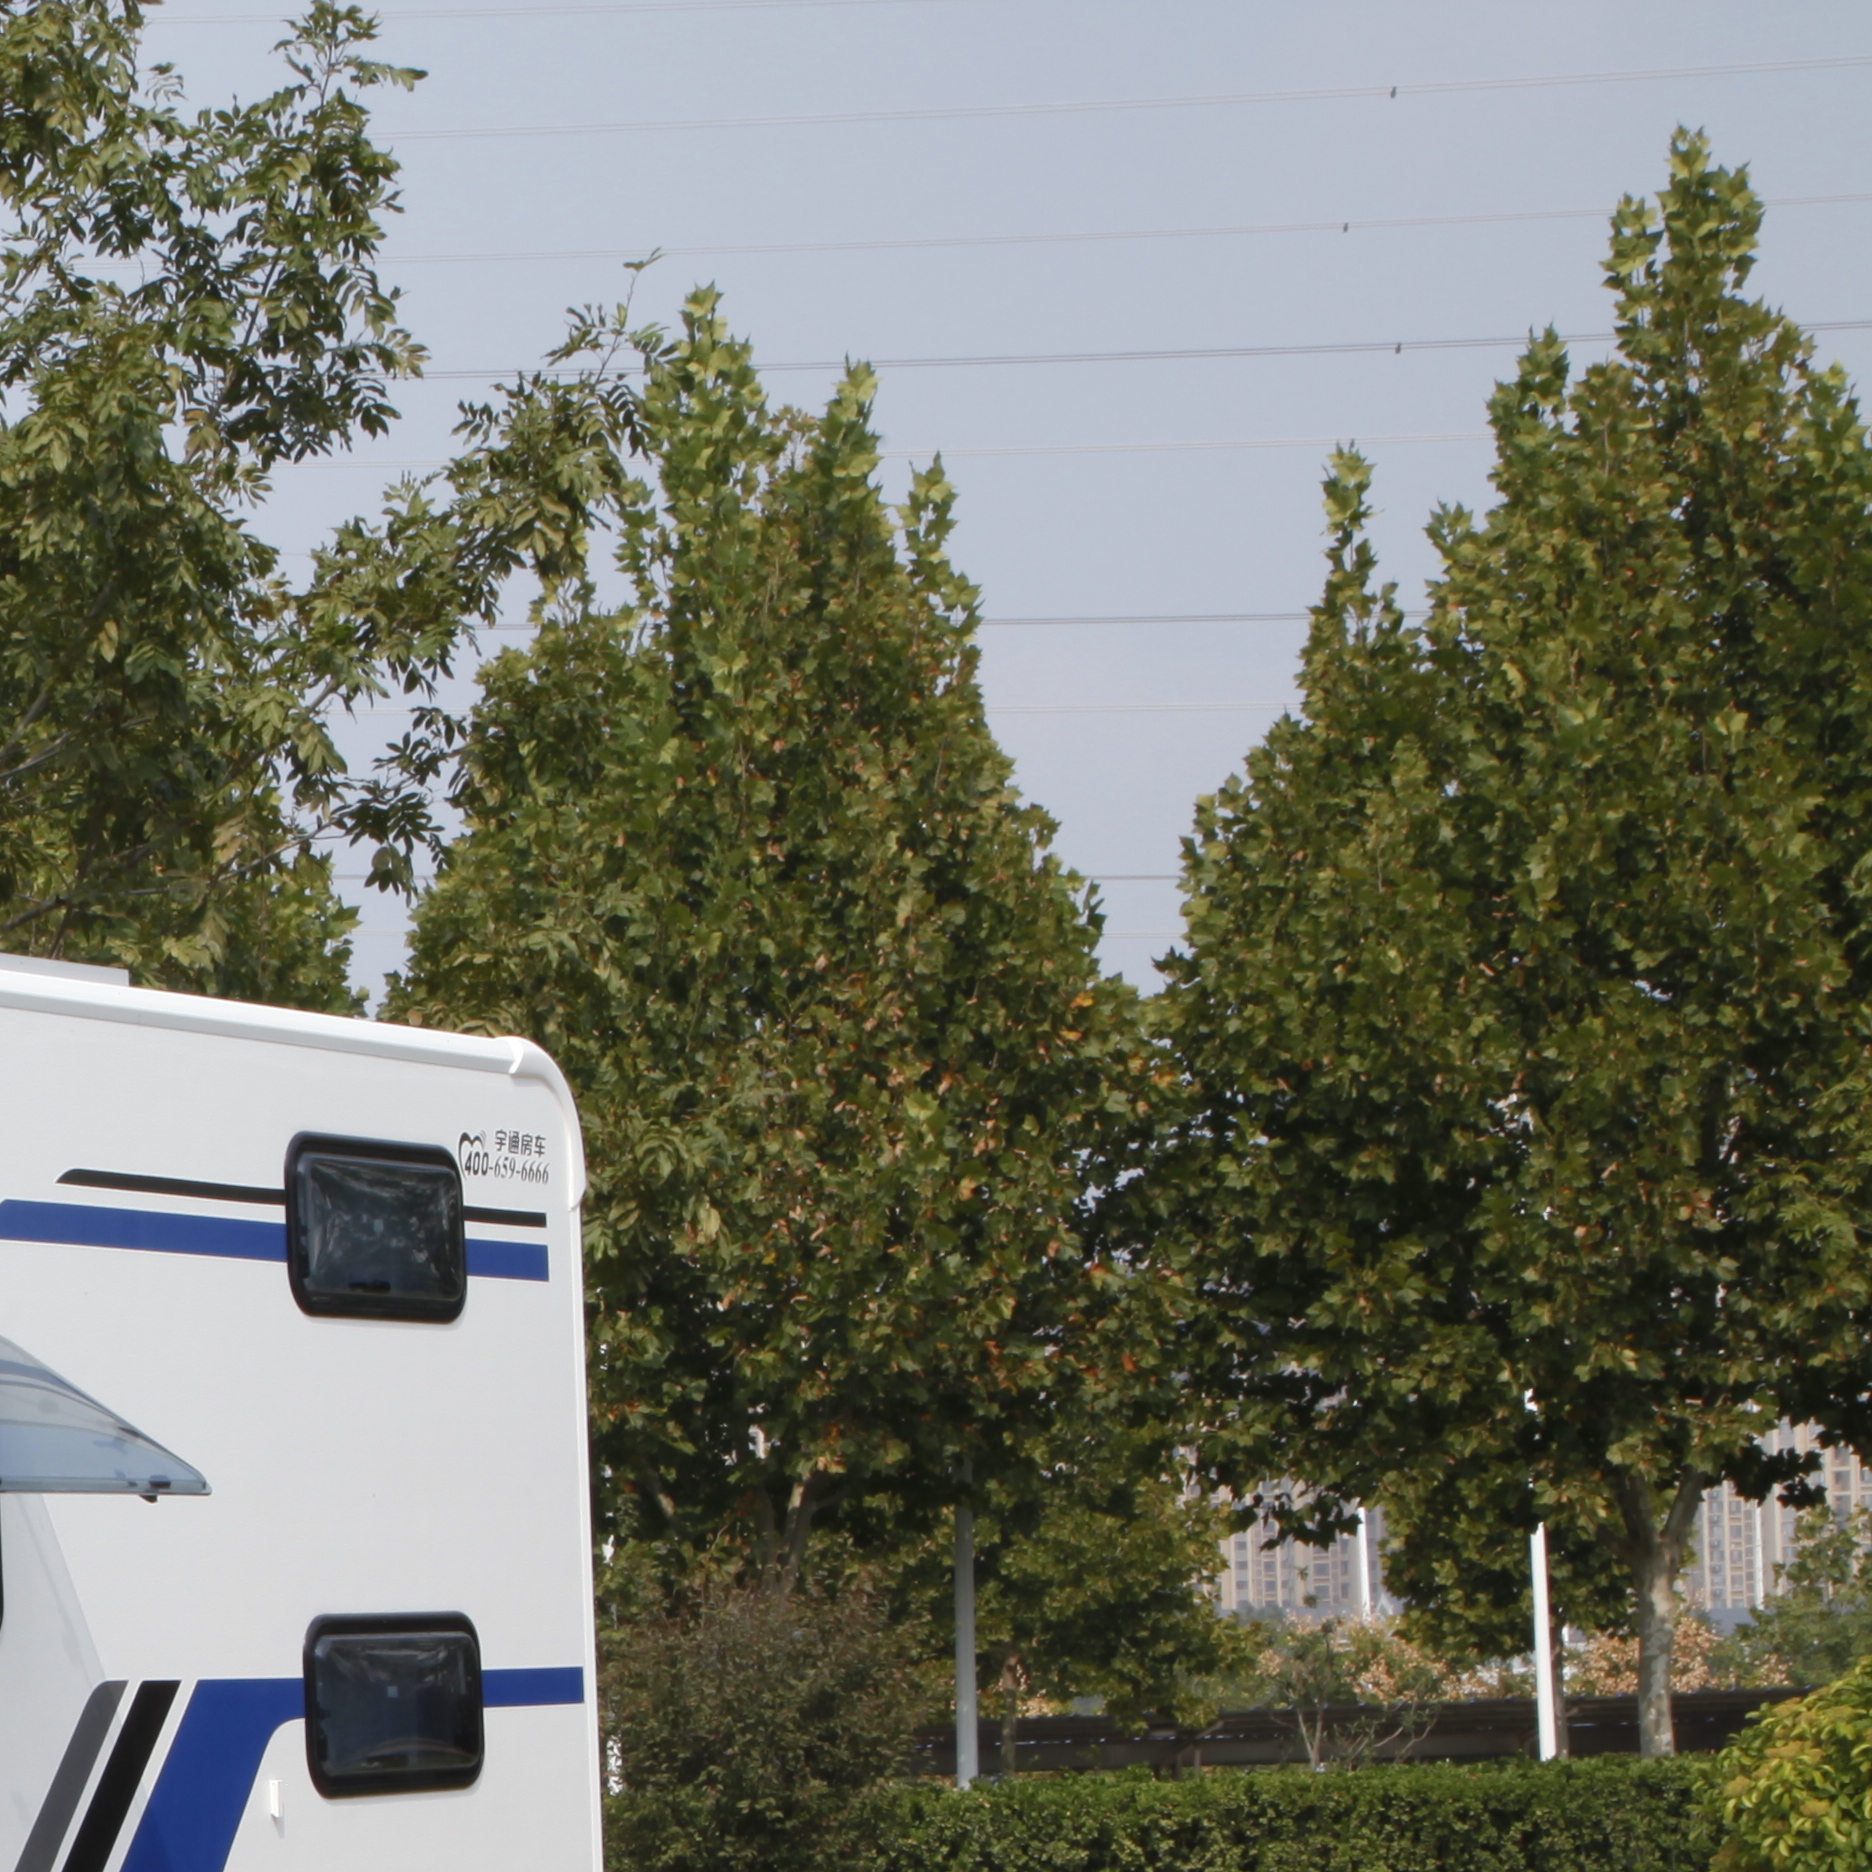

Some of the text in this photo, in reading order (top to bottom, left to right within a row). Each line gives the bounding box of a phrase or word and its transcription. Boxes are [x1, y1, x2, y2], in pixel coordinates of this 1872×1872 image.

[494, 1129, 547, 1158] 宇通房车
[464, 1151, 551, 1184] 400-659-6666
